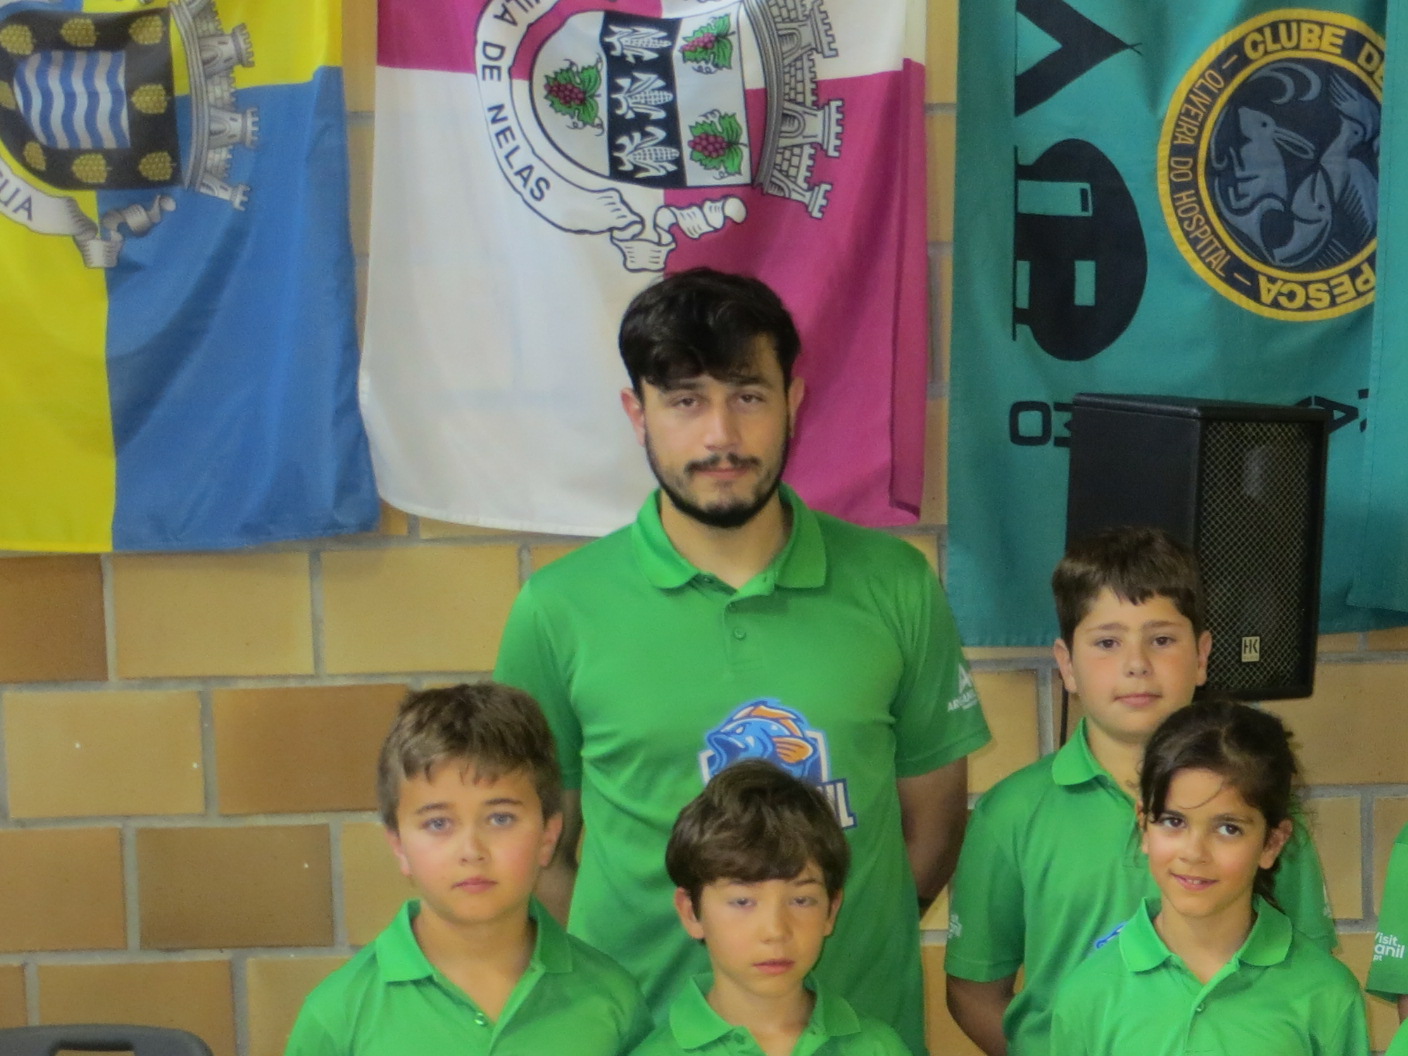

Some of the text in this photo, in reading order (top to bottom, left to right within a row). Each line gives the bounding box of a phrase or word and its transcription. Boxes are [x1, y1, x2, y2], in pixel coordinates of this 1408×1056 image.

[482, 40, 507, 82] DE
[1243, 21, 1347, 60] CLUBE
[487, 103, 551, 202] NELAS
[1170, 69, 1233, 278] OLIVEIRA DO HOSPITAL
[1257, 261, 1377, 309] PESCA
